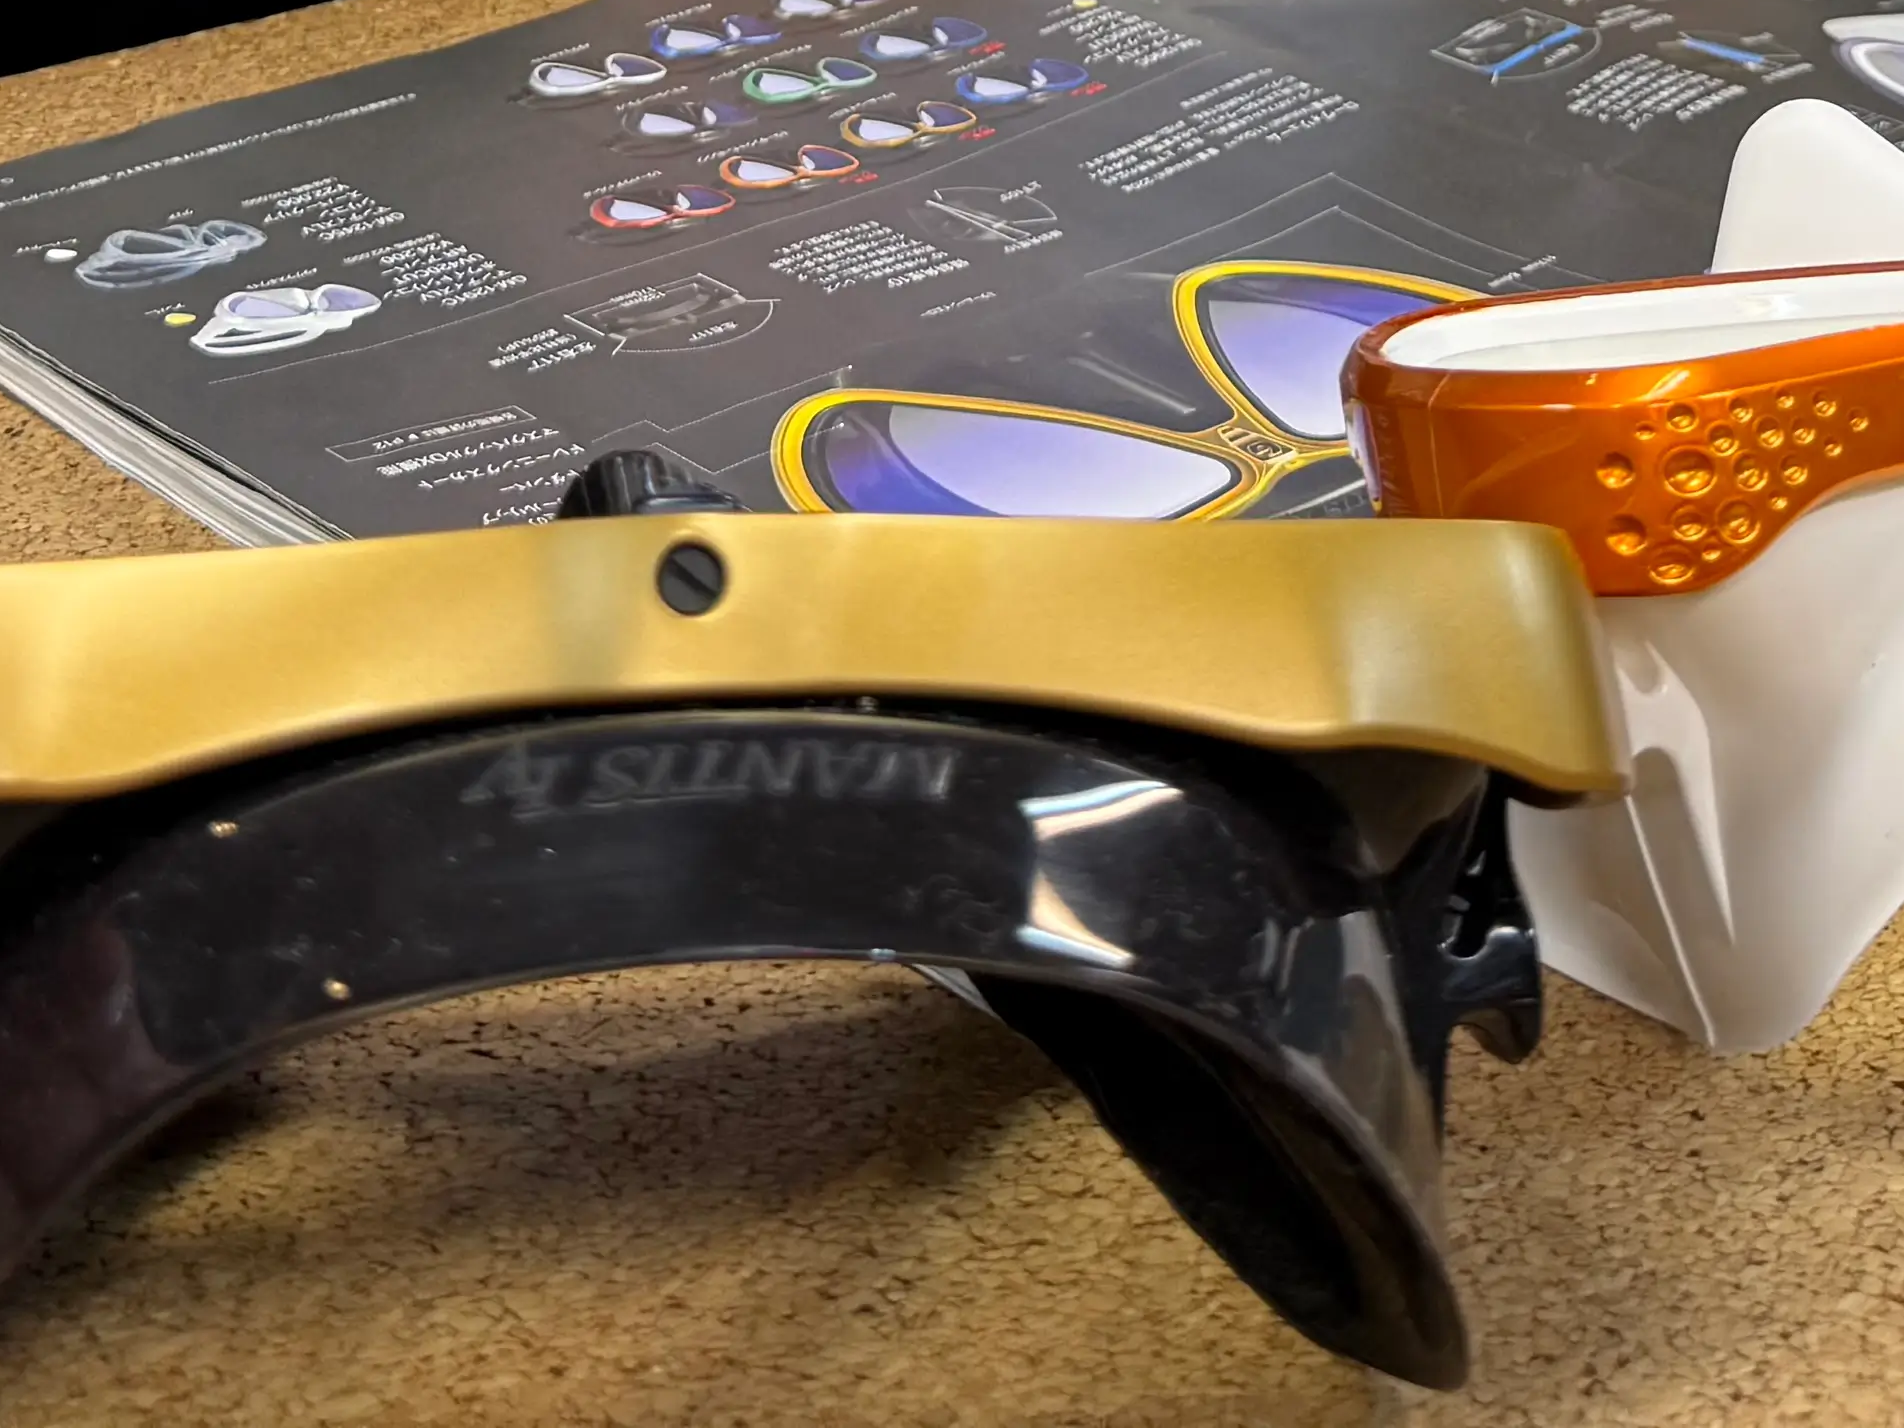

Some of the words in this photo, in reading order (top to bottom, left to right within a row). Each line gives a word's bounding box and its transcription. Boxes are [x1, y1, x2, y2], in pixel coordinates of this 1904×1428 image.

[392, 252, 485, 287] UV420CUT
[375, 427, 560, 477] マスクバックルDX機能
[582, 739, 962, 808] MANTIS
